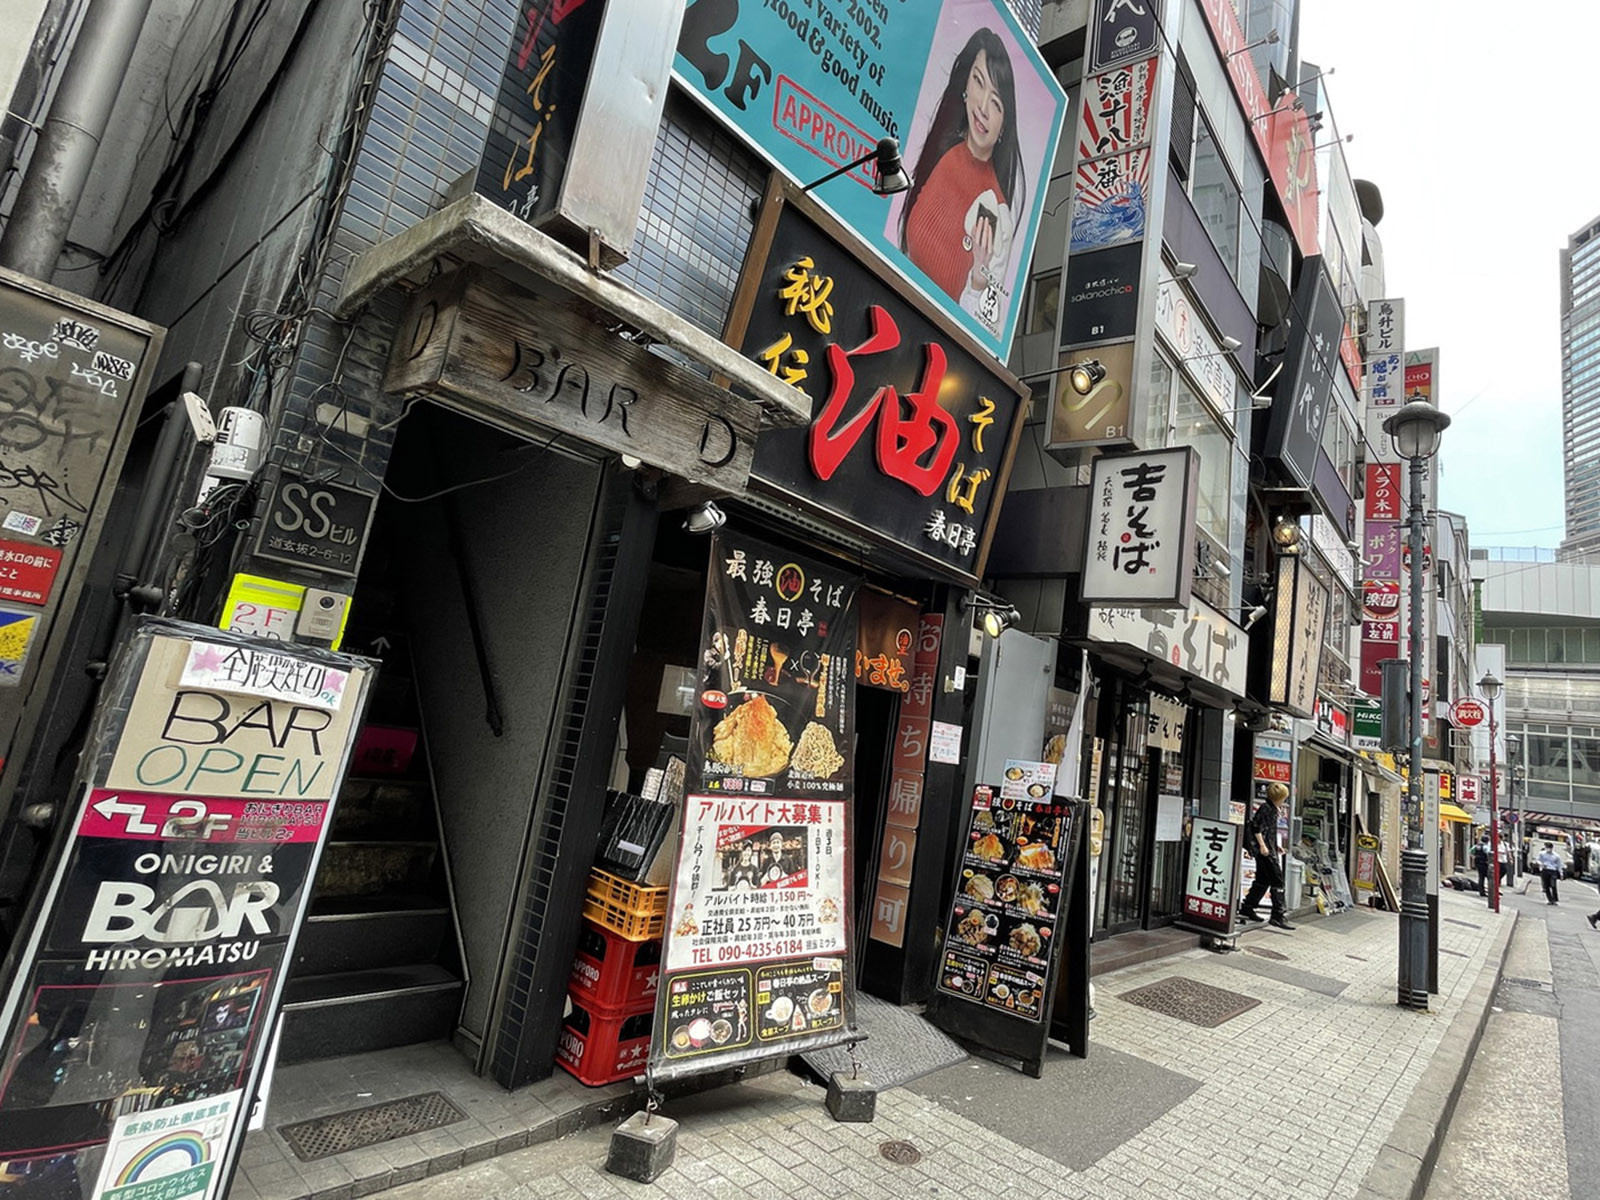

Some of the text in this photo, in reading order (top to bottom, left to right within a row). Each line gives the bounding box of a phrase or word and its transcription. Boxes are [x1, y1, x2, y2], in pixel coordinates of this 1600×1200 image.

[817, 0, 886, 87] variety of
[859, 88, 900, 140] music.
[783, 93, 884, 182] APPROVE
[760, 256, 834, 393] 秘伝
[1091, 325, 1104, 336] B1
[500, 340, 738, 469] BAR D
[809, 304, 960, 497] 油
[1106, 425, 1125, 438] B1
[945, 396, 996, 515] そば
[1374, 465, 1393, 512] バラの木
[925, 509, 977, 556] 春日亭
[1113, 462, 1167, 574] 吉そば
[268, 535, 353, 567] 道玄坂2-6-12
[234, 602, 288, 629] 2F
[749, 595, 816, 637] 春日亭
[1366, 592, 1399, 607] 楽園
[1369, 630, 1393, 640] 左折
[161, 690, 333, 756] BAR
[136, 744, 325, 797] OPEN
[1461, 778, 1477, 801] 中華
[161, 800, 232, 840] 2F
[244, 802, 324, 815] おにぎりBAR
[134, 852, 274, 875] ONIGIRI &
[1197, 827, 1229, 896] 吉そば
[82, 879, 281, 943] BAR
[701, 917, 734, 936] 正社員
[738, 917, 752, 932] 25
[783, 914, 796, 928] 40
[1188, 898, 1227, 918] 営業中
[84, 940, 260, 971] HIROMATSU
[692, 939, 804, 963] TEL 090-4235-6184
[123, 1101, 231, 1137] 感染防止徹底宣言
[109, 1168, 207, 1200] 新型コロナウイルス
